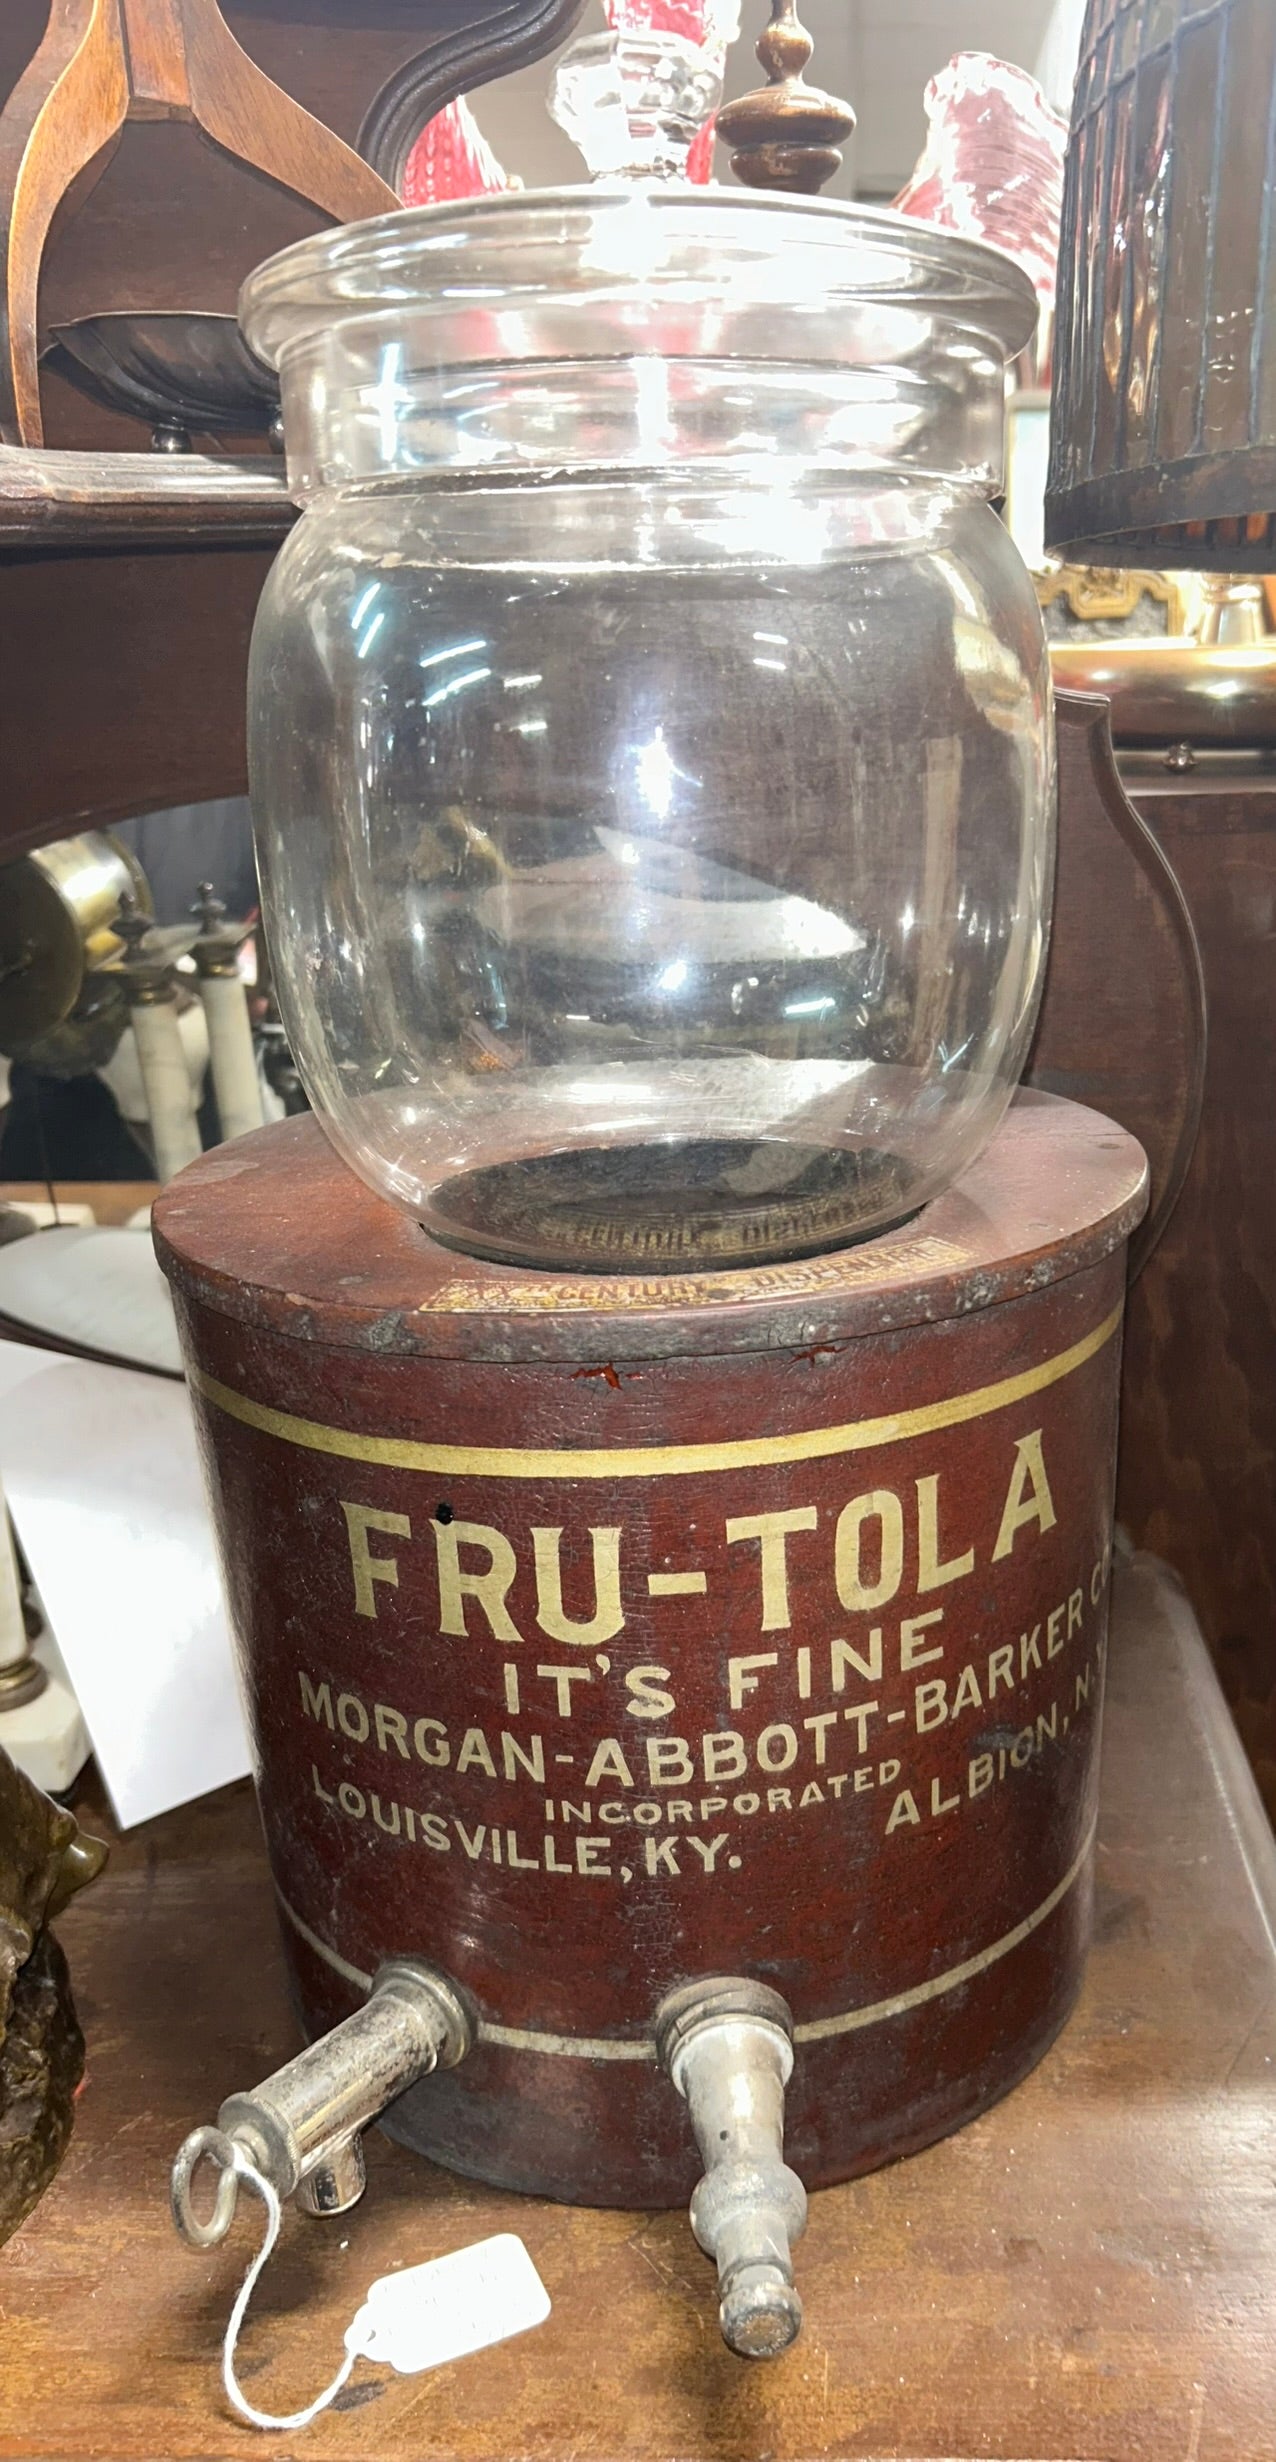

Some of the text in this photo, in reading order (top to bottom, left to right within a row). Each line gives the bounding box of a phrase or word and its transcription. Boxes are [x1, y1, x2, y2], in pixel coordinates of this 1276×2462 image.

[554, 1277, 709, 1301] CENTURY
[754, 1244, 938, 1288] DISPENSER
[340, 1428, 1057, 1643] FRU-TOLA
[298, 1586, 1084, 1788] MORGAN-ABBOTT-BARKER
[503, 1608, 945, 1718] IT'S FINE
[312, 1764, 743, 1884] LOUISVILLE, KY.
[545, 1758, 900, 1825] INCORPORATED
[885, 1701, 1070, 1836] ALBION,
